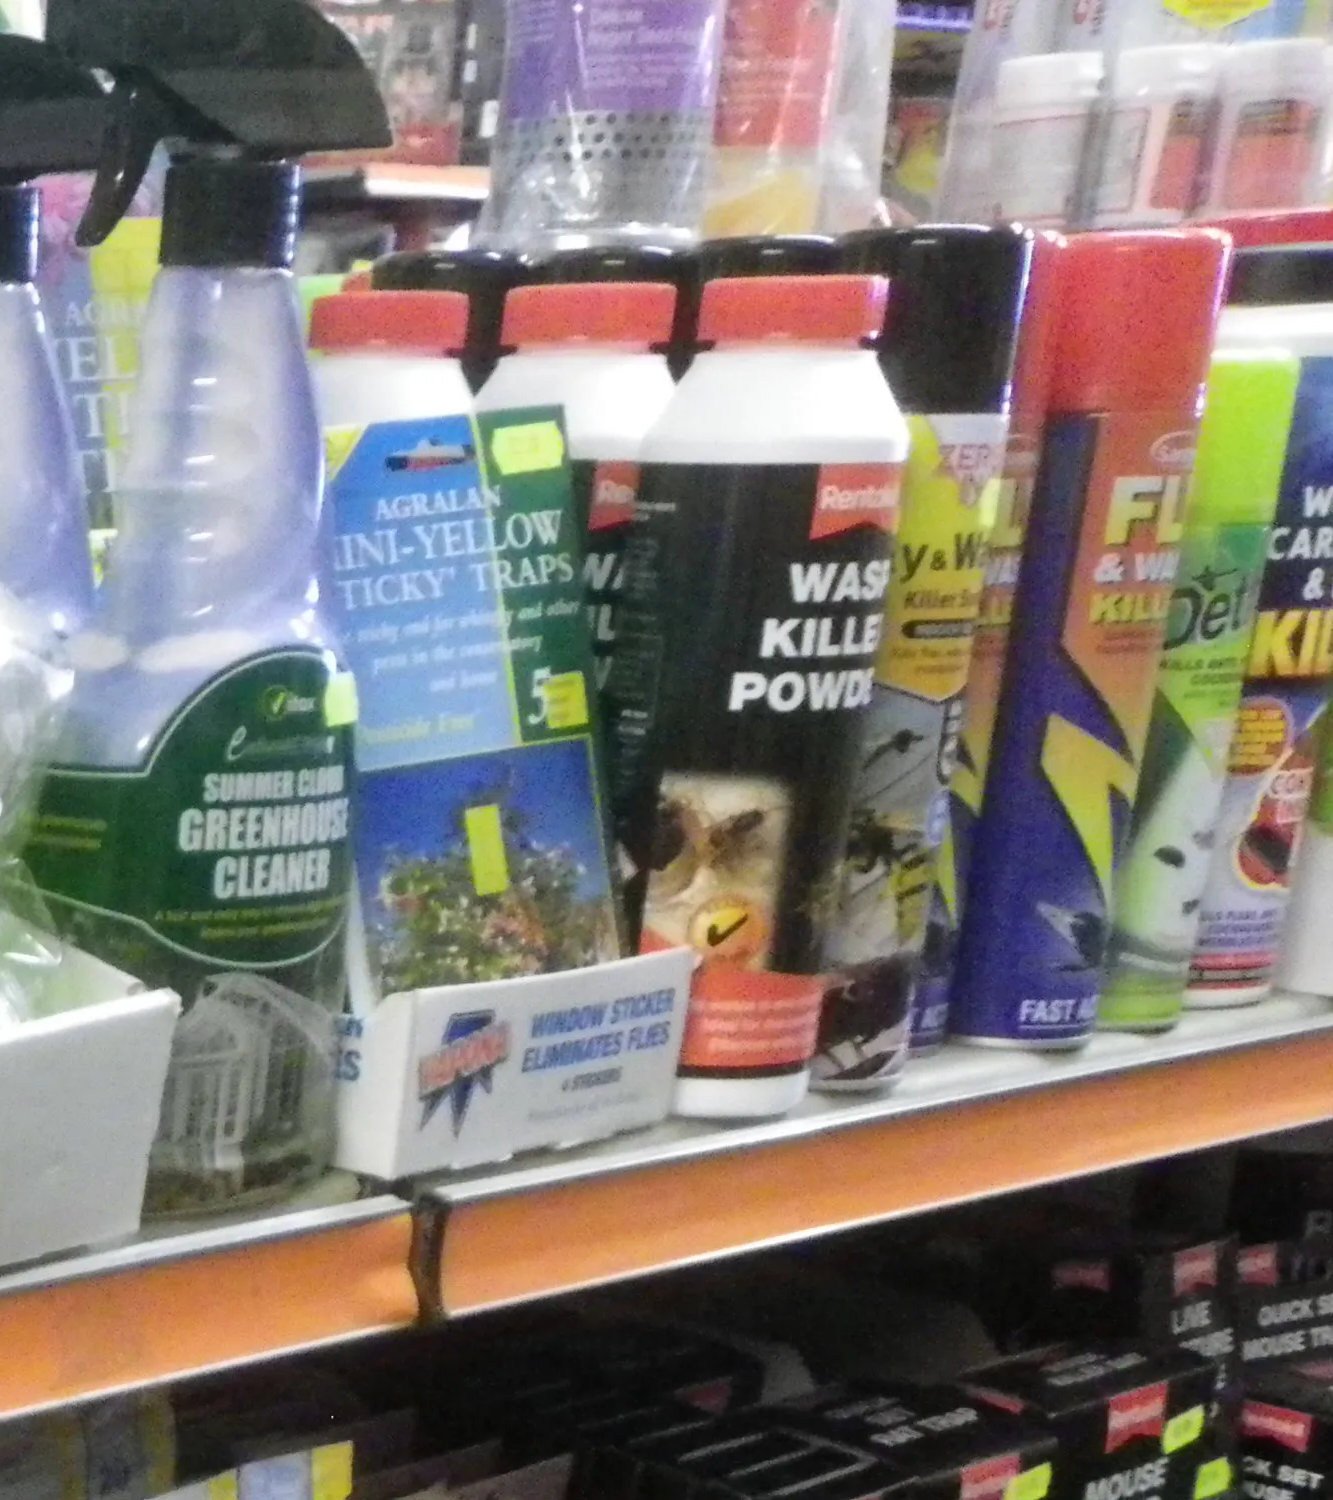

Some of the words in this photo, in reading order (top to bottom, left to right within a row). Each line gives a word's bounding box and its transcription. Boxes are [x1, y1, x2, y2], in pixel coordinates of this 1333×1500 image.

[376, 484, 502, 521] AGRALAN
[468, 552, 575, 593] TRAPS
[202, 770, 295, 804] SUMMER
[177, 797, 350, 853] GREENHOUSE
[212, 849, 332, 900] CLEANER
